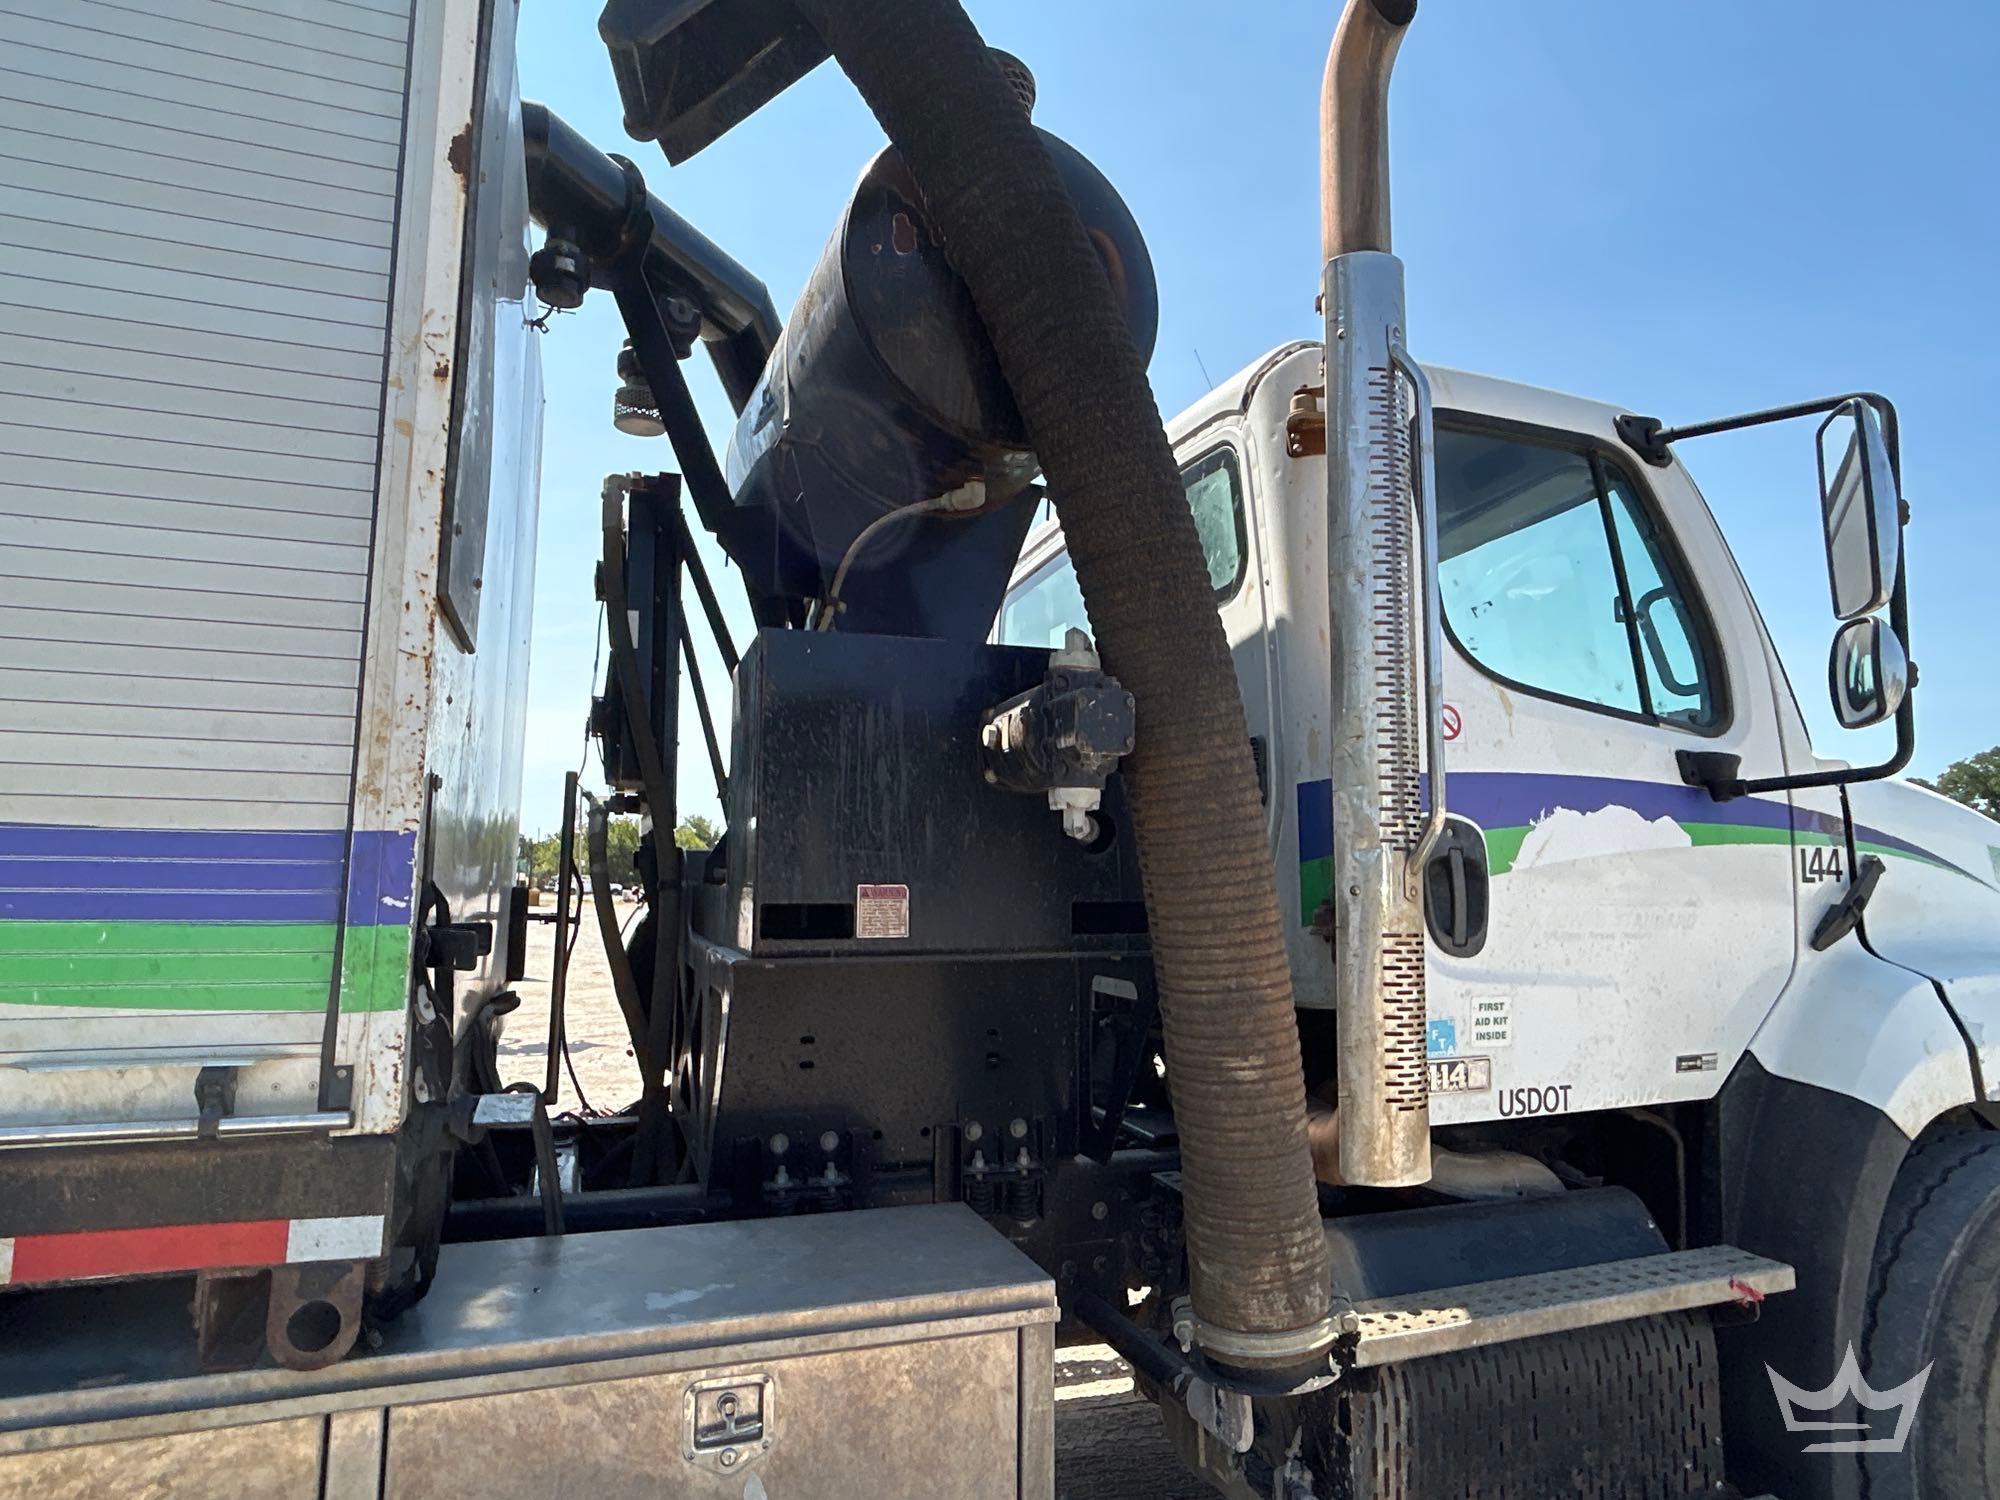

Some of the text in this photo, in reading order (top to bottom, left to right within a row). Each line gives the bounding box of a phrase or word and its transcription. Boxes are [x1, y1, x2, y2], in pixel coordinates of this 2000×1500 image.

[1801, 847, 1843, 883] L44
[1478, 1002, 1505, 1012] FIRST
[1475, 1016, 1509, 1026] AID KIT
[1475, 1031, 1507, 1041] INSIDE
[1499, 1085, 1572, 1117] USDOT
